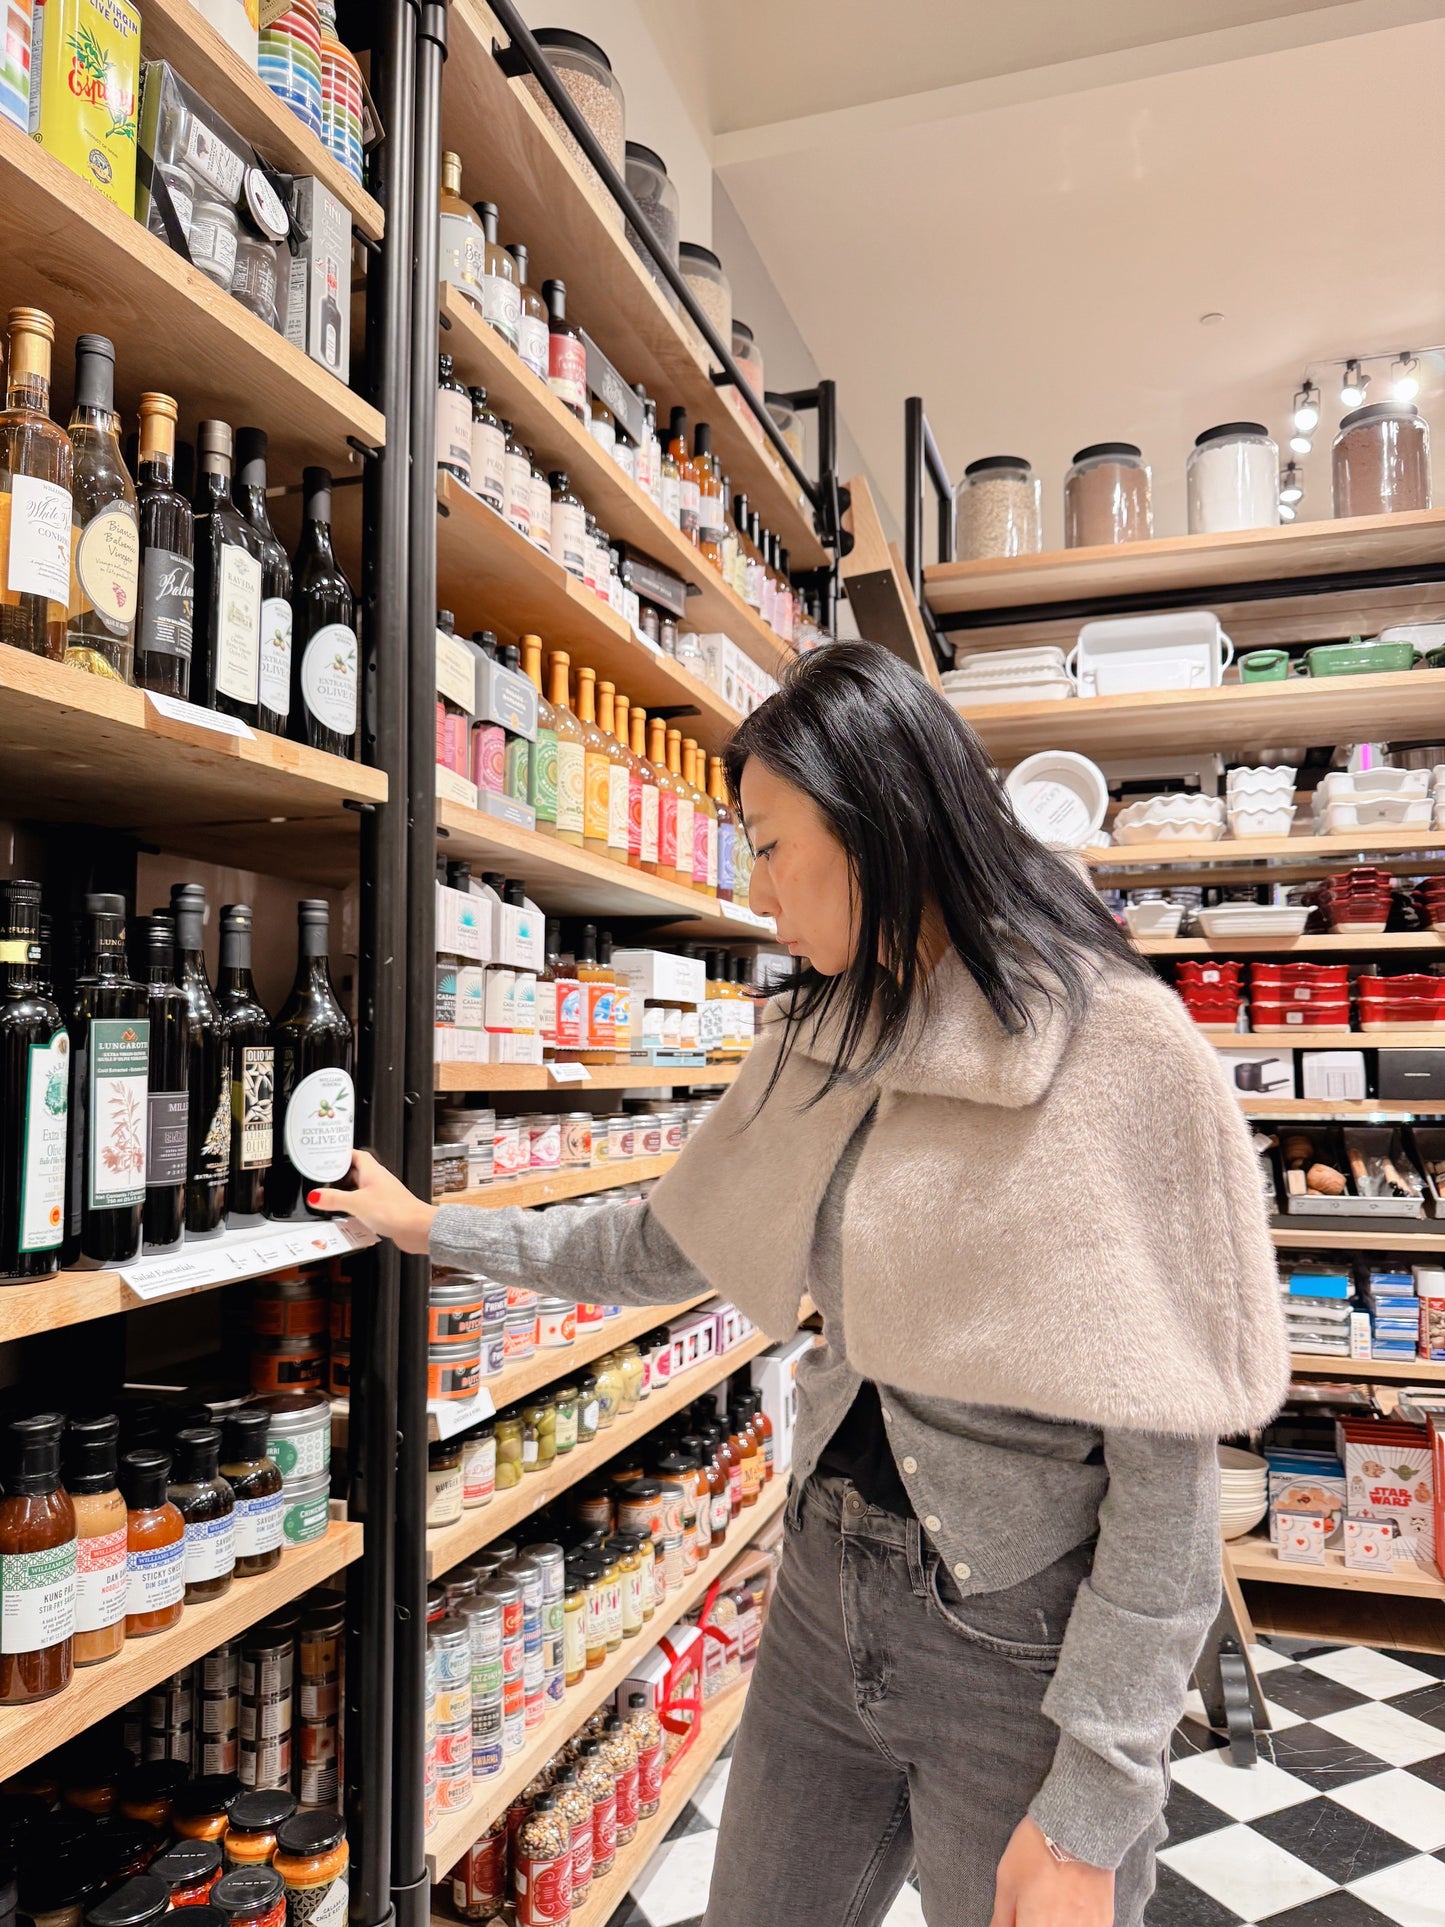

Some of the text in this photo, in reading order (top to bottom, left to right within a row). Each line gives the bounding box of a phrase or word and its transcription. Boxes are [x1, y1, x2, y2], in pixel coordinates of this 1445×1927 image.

[90, 0, 128, 38] LIVE OIL
[107, 0, 138, 34] VIRGIN
[325, 200, 341, 225] FINI
[248, 1051, 264, 1062] OLIO
[301, 1137, 336, 1147] OLIVE
[131, 1270, 155, 1283] Salad
[156, 1262, 196, 1280] Essentials
[1369, 1486, 1412, 1498] STAR
[1369, 1495, 1412, 1507] WARS
[139, 1553, 170, 1565] WILLIAMS
[31, 1559, 64, 1576] WILLIAMS
[142, 1562, 183, 1582] STICKY SWEET
[107, 1573, 118, 1584] DAN
[145, 1580, 157, 1590] DIM
[157, 1577, 168, 1587] SUM
[44, 1590, 63, 1604] KUNG
[39, 1600, 64, 1614] STIR-FRY
